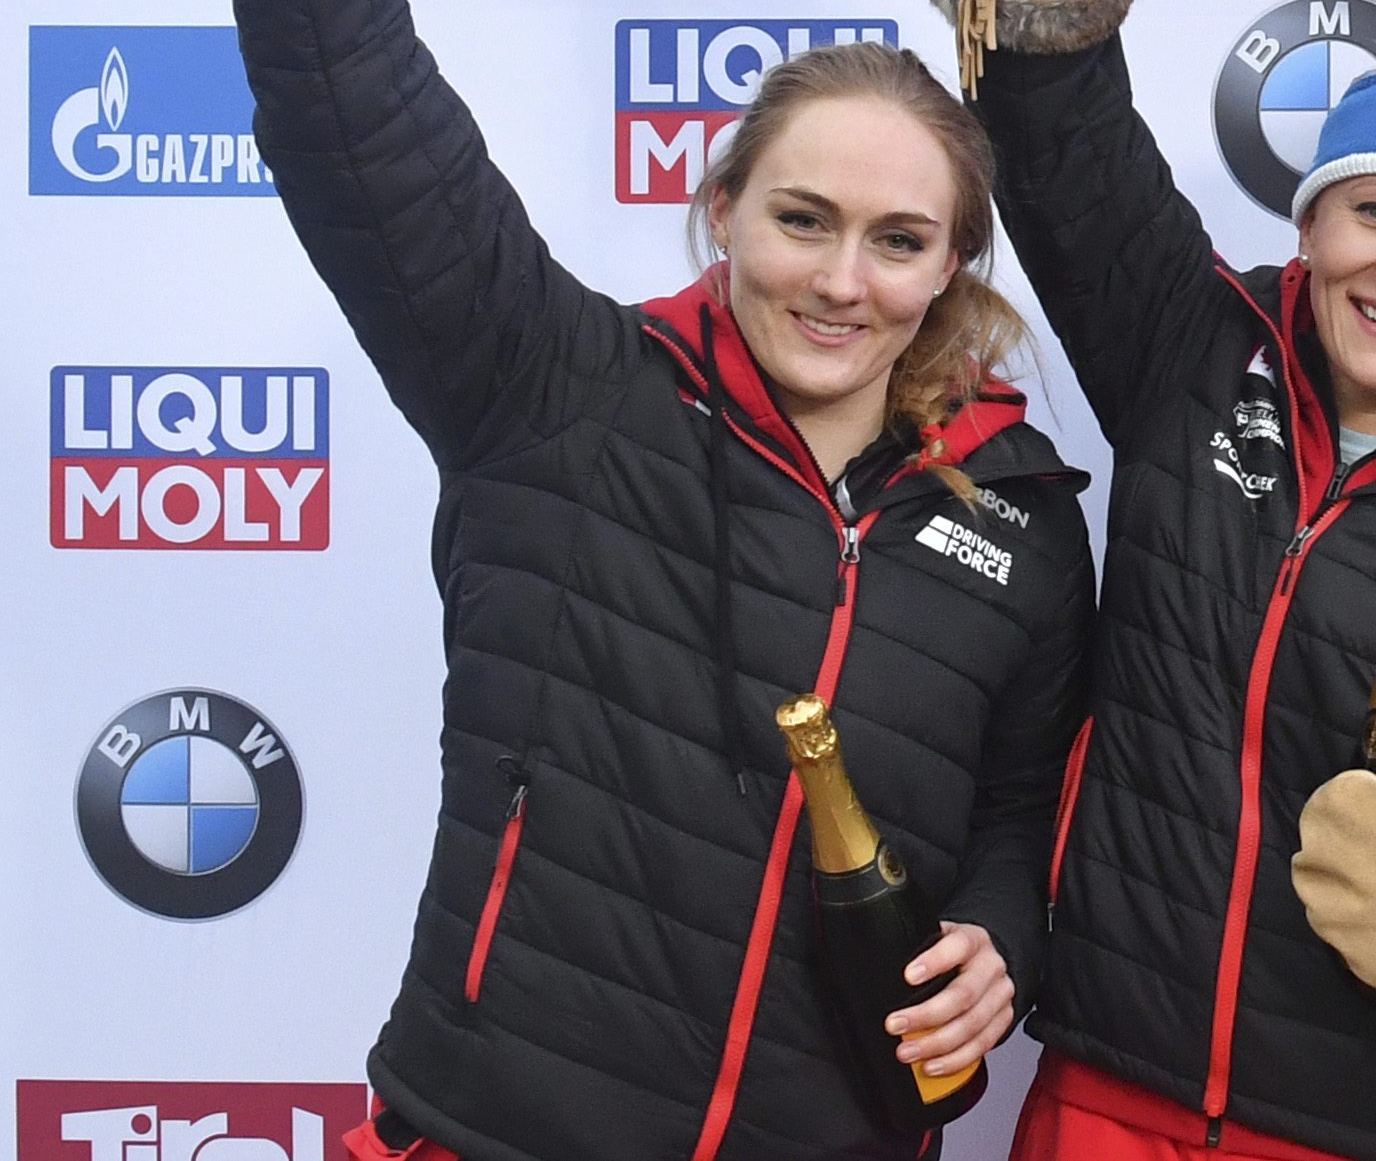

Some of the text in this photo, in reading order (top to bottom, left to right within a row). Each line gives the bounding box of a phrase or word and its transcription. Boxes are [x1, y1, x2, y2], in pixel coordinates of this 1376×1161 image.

[136, 134, 275, 184] GAZPR
[64, 374, 316, 457] LIQUI
[64, 465, 324, 542] MOLY
[944, 538, 1009, 586] FORCE
[952, 523, 1012, 568] DRIVING
[100, 696, 285, 769] BMW
